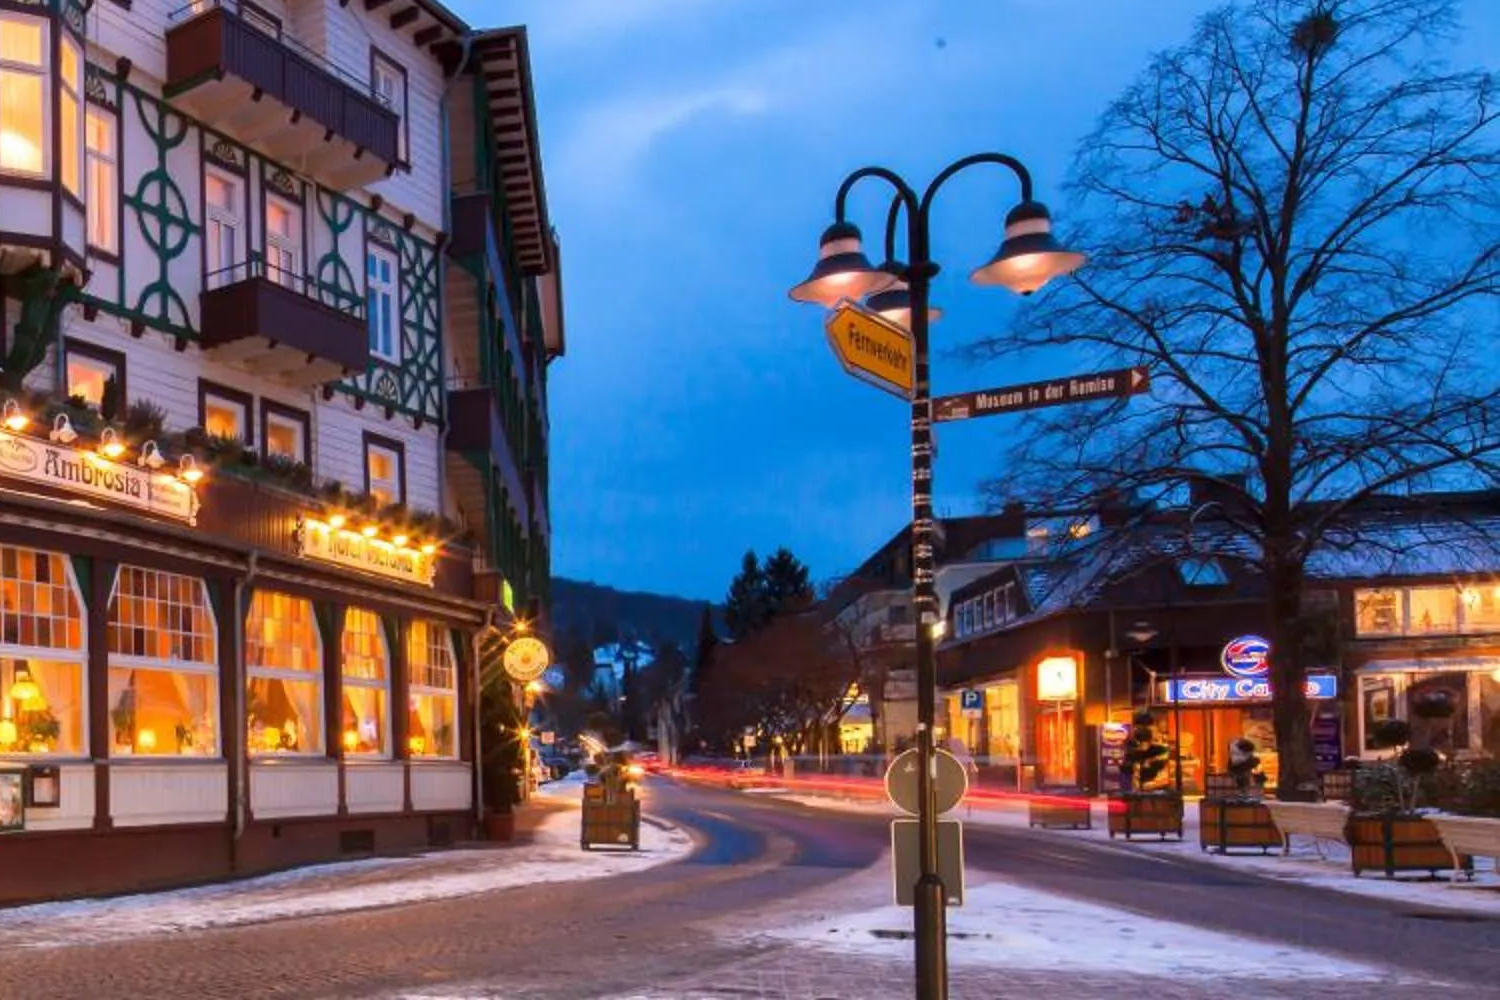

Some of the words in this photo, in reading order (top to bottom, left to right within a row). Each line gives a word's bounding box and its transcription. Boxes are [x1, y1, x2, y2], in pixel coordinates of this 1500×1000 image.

[848, 321, 908, 374] Fernverkehr
[975, 390, 1023, 410] Museum
[1029, 386, 1040, 402] in
[1045, 383, 1065, 400] der
[1069, 377, 1116, 397] Remise
[44, 448, 141, 497] Ambrosia
[965, 691, 977, 706] P
[1182, 680, 1229, 699] City
